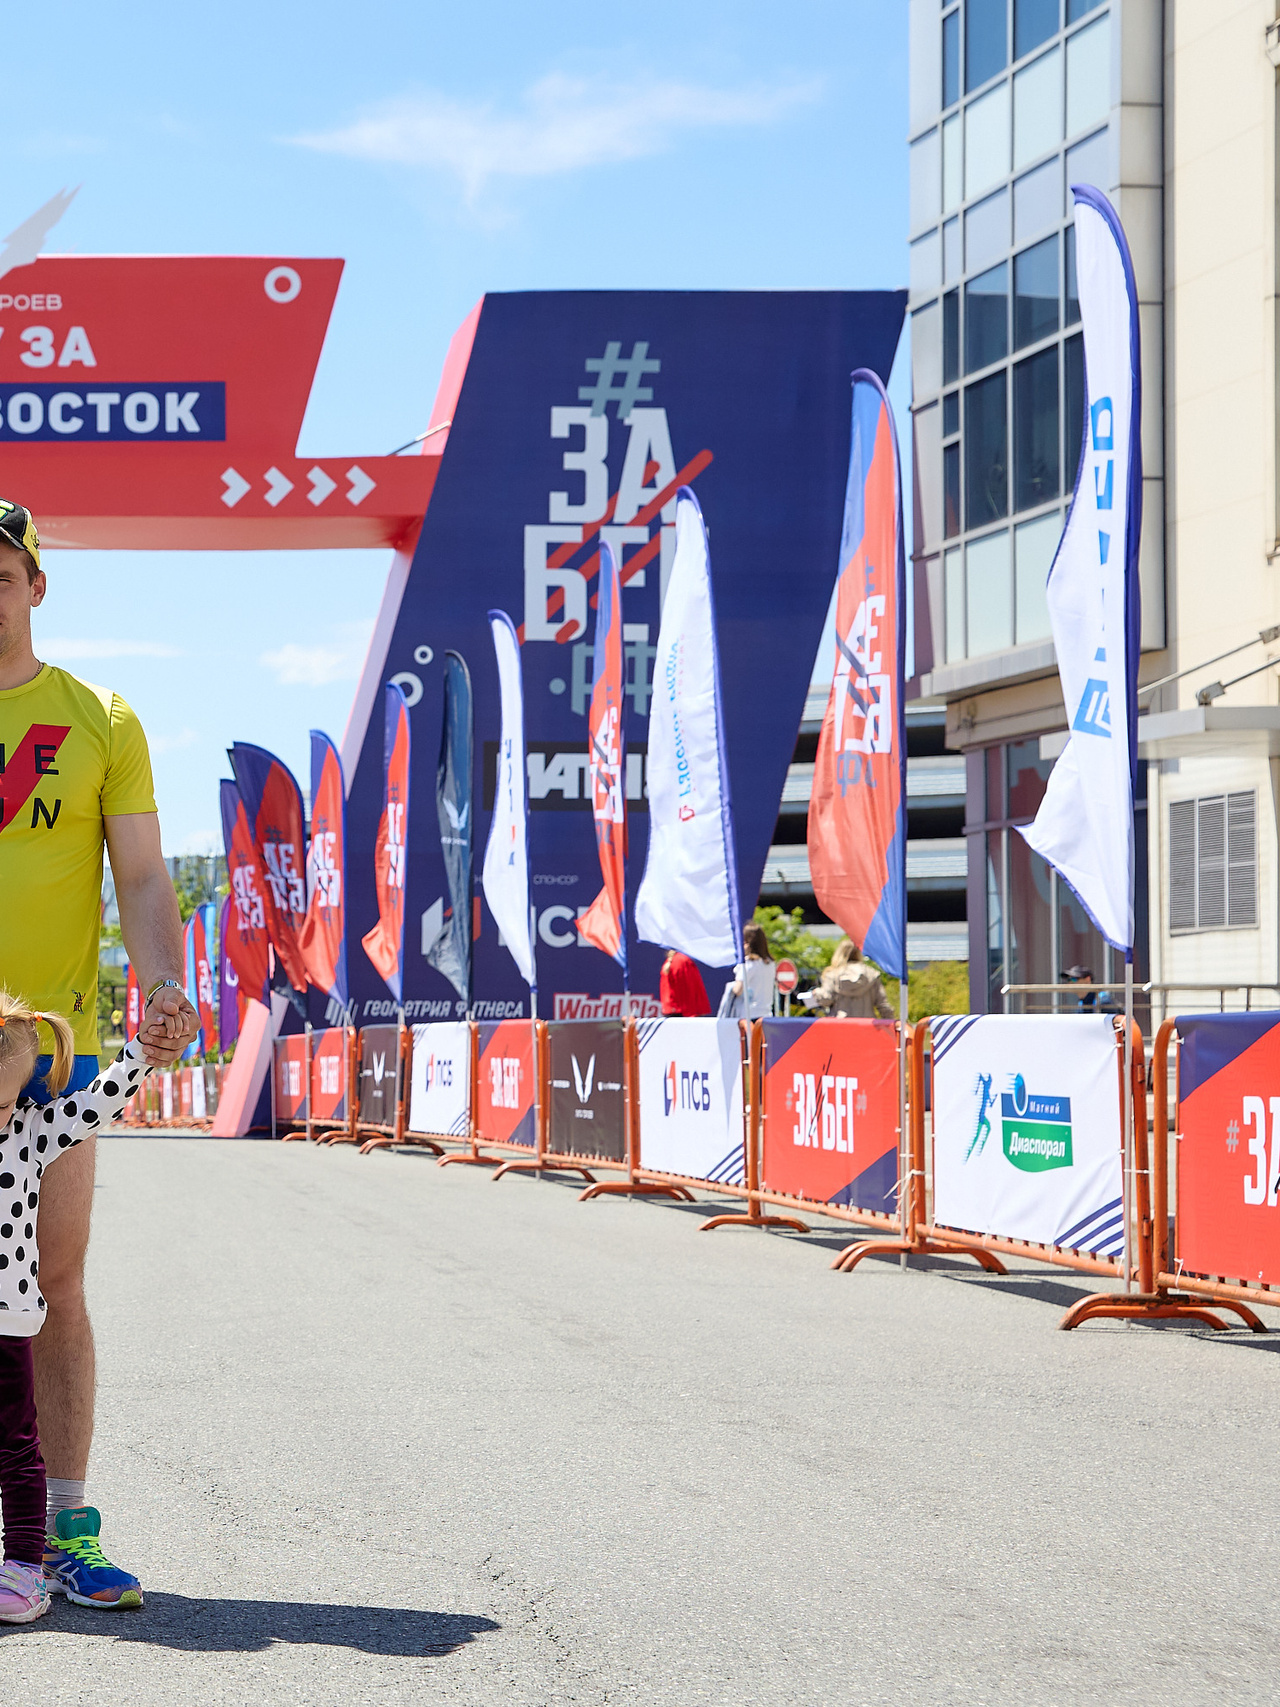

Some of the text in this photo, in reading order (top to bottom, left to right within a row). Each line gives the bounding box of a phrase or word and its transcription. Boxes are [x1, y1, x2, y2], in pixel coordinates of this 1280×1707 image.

[19, 325, 98, 369] ЗА
[681, 1070, 711, 1112] ПСБ
[1008, 1131, 1066, 1161] Диаспорал
